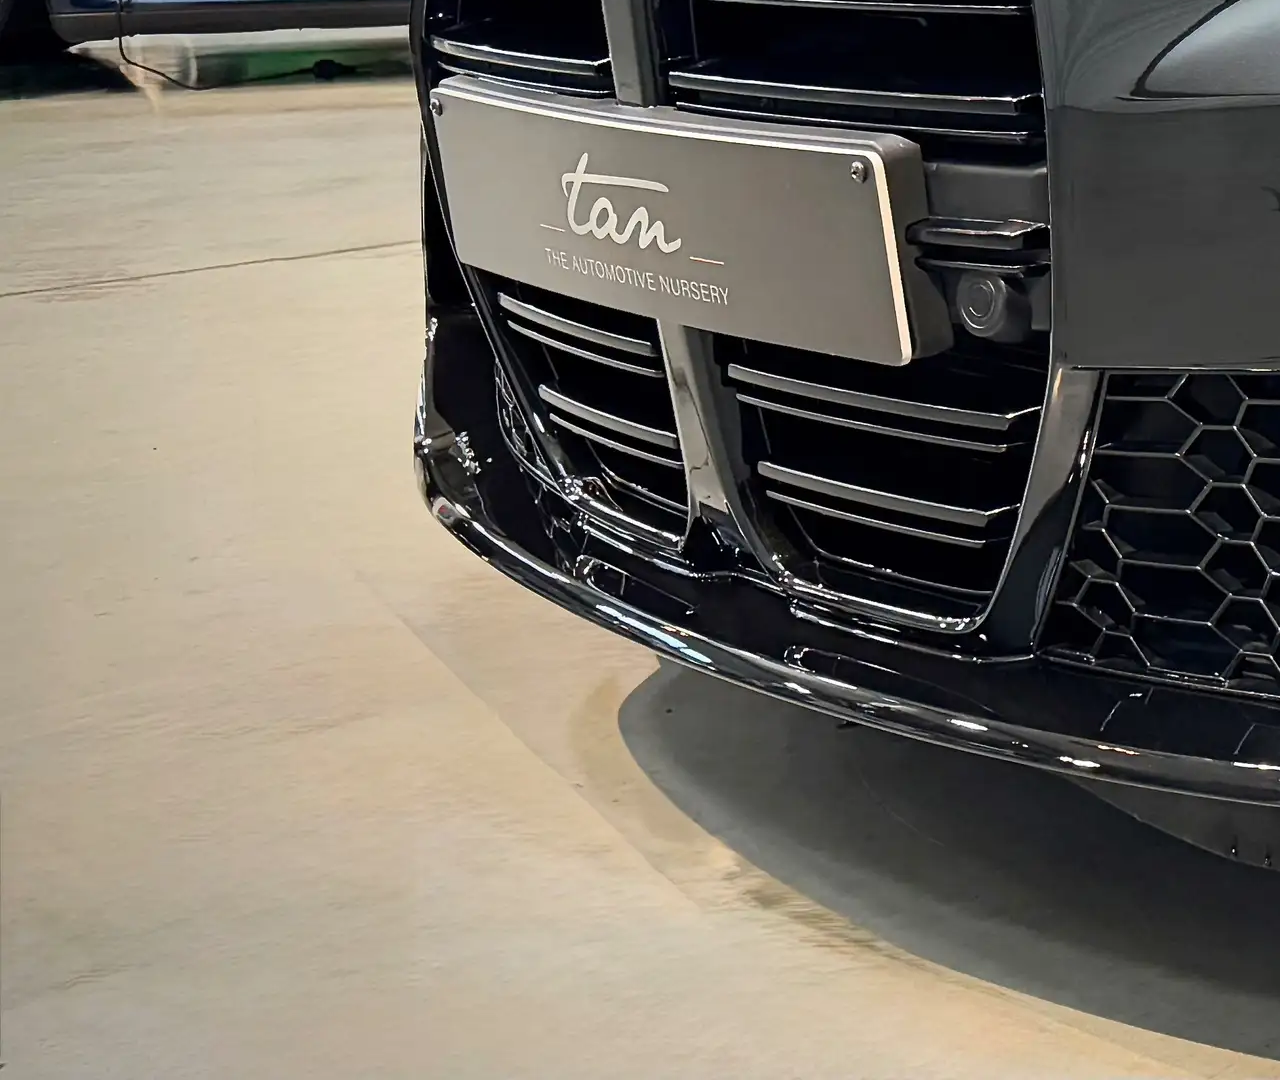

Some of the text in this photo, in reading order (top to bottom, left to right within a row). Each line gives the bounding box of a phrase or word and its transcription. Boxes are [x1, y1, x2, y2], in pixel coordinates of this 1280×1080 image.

[561, 152, 682, 253] tan
[544, 247, 729, 306] THE AUTOMOTIVE NURSERY
